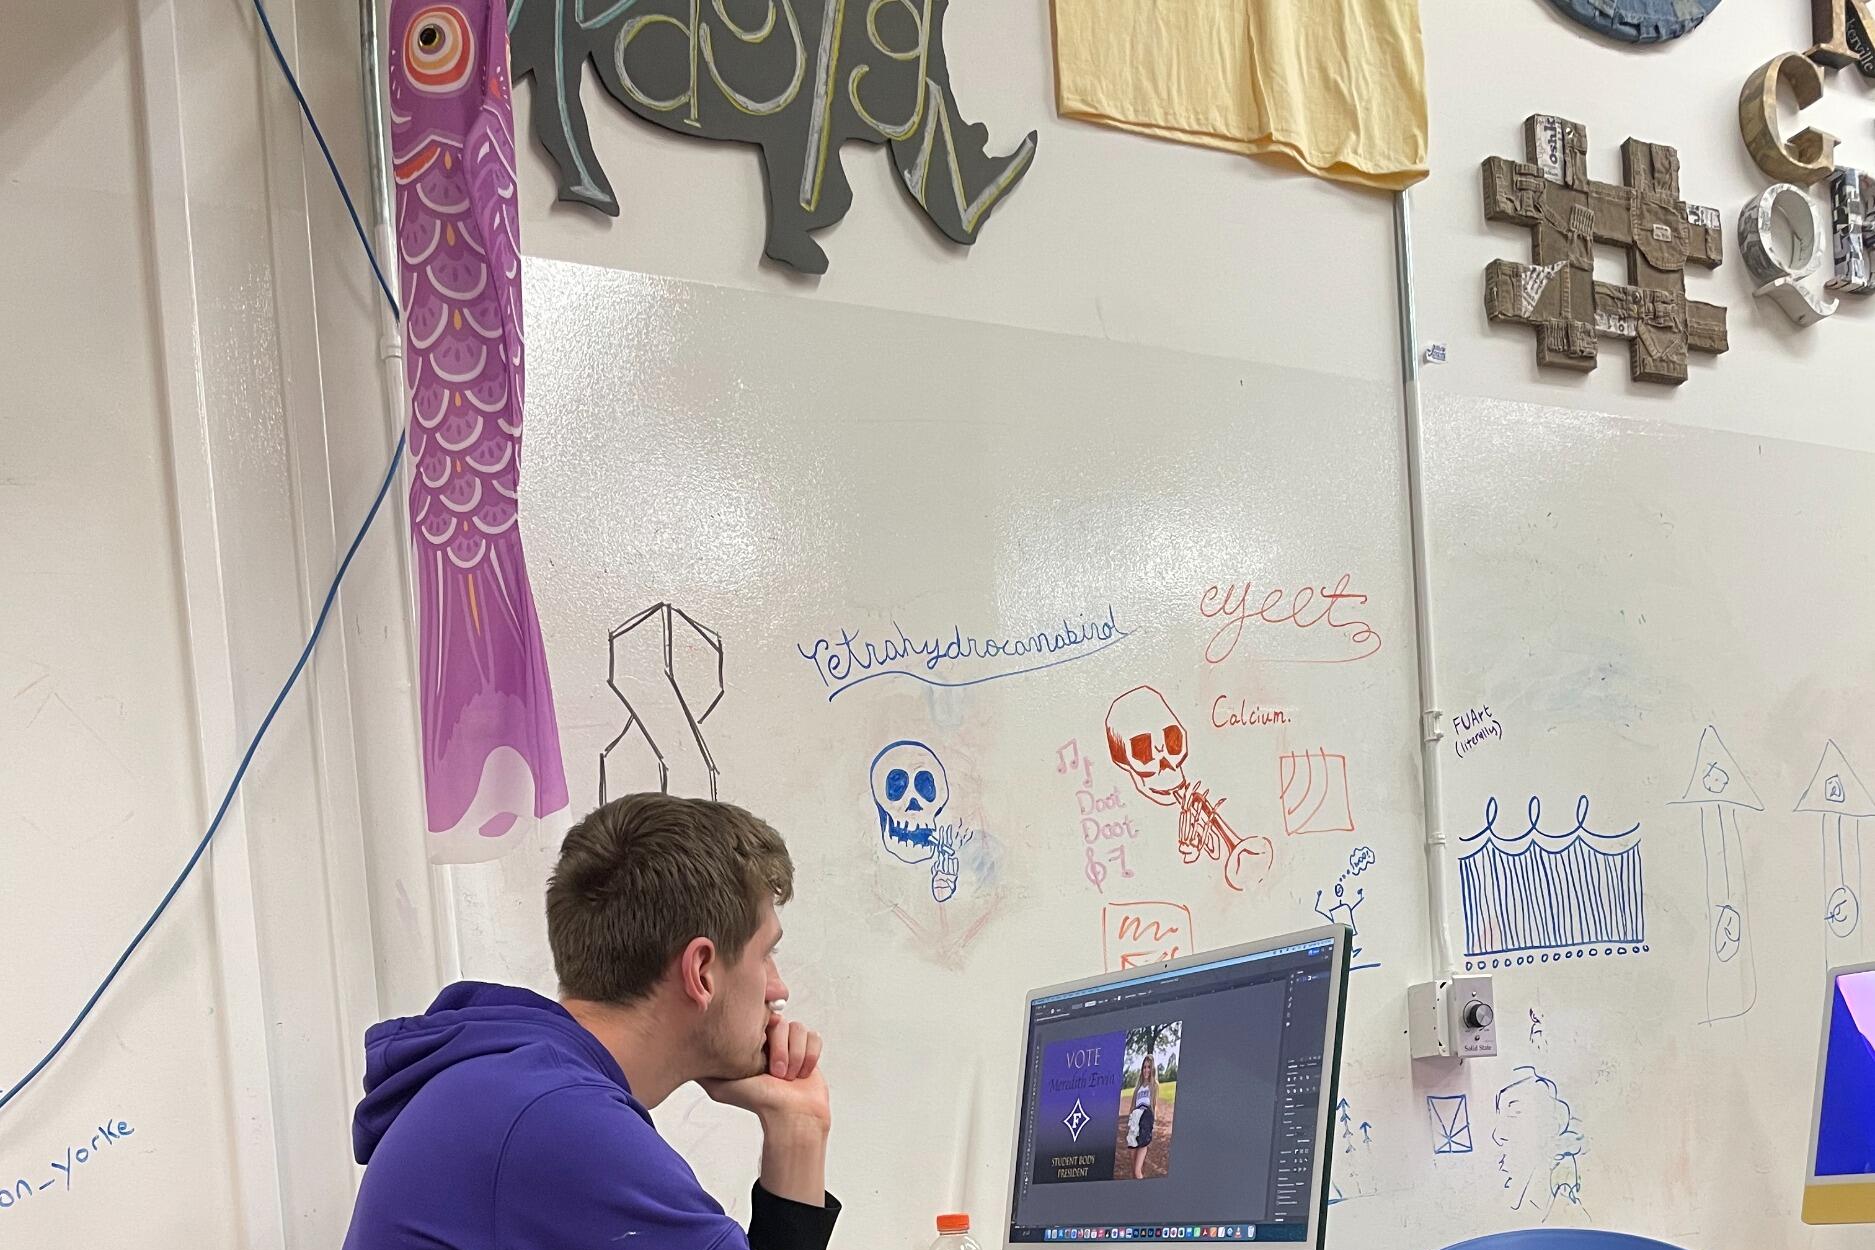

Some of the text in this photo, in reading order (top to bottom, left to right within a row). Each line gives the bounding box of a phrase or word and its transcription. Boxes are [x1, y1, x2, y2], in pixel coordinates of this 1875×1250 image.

[1212, 694, 1291, 728] Calcium.
[1455, 719, 1503, 759] (literally)
[1075, 786, 1126, 815] Doot
[1080, 815, 1140, 845] Doot
[1066, 1047, 1101, 1070] VOTE
[1051, 1154, 1096, 1168] STUDENT BODY
[1057, 1167, 1089, 1179] PRESIDENT
